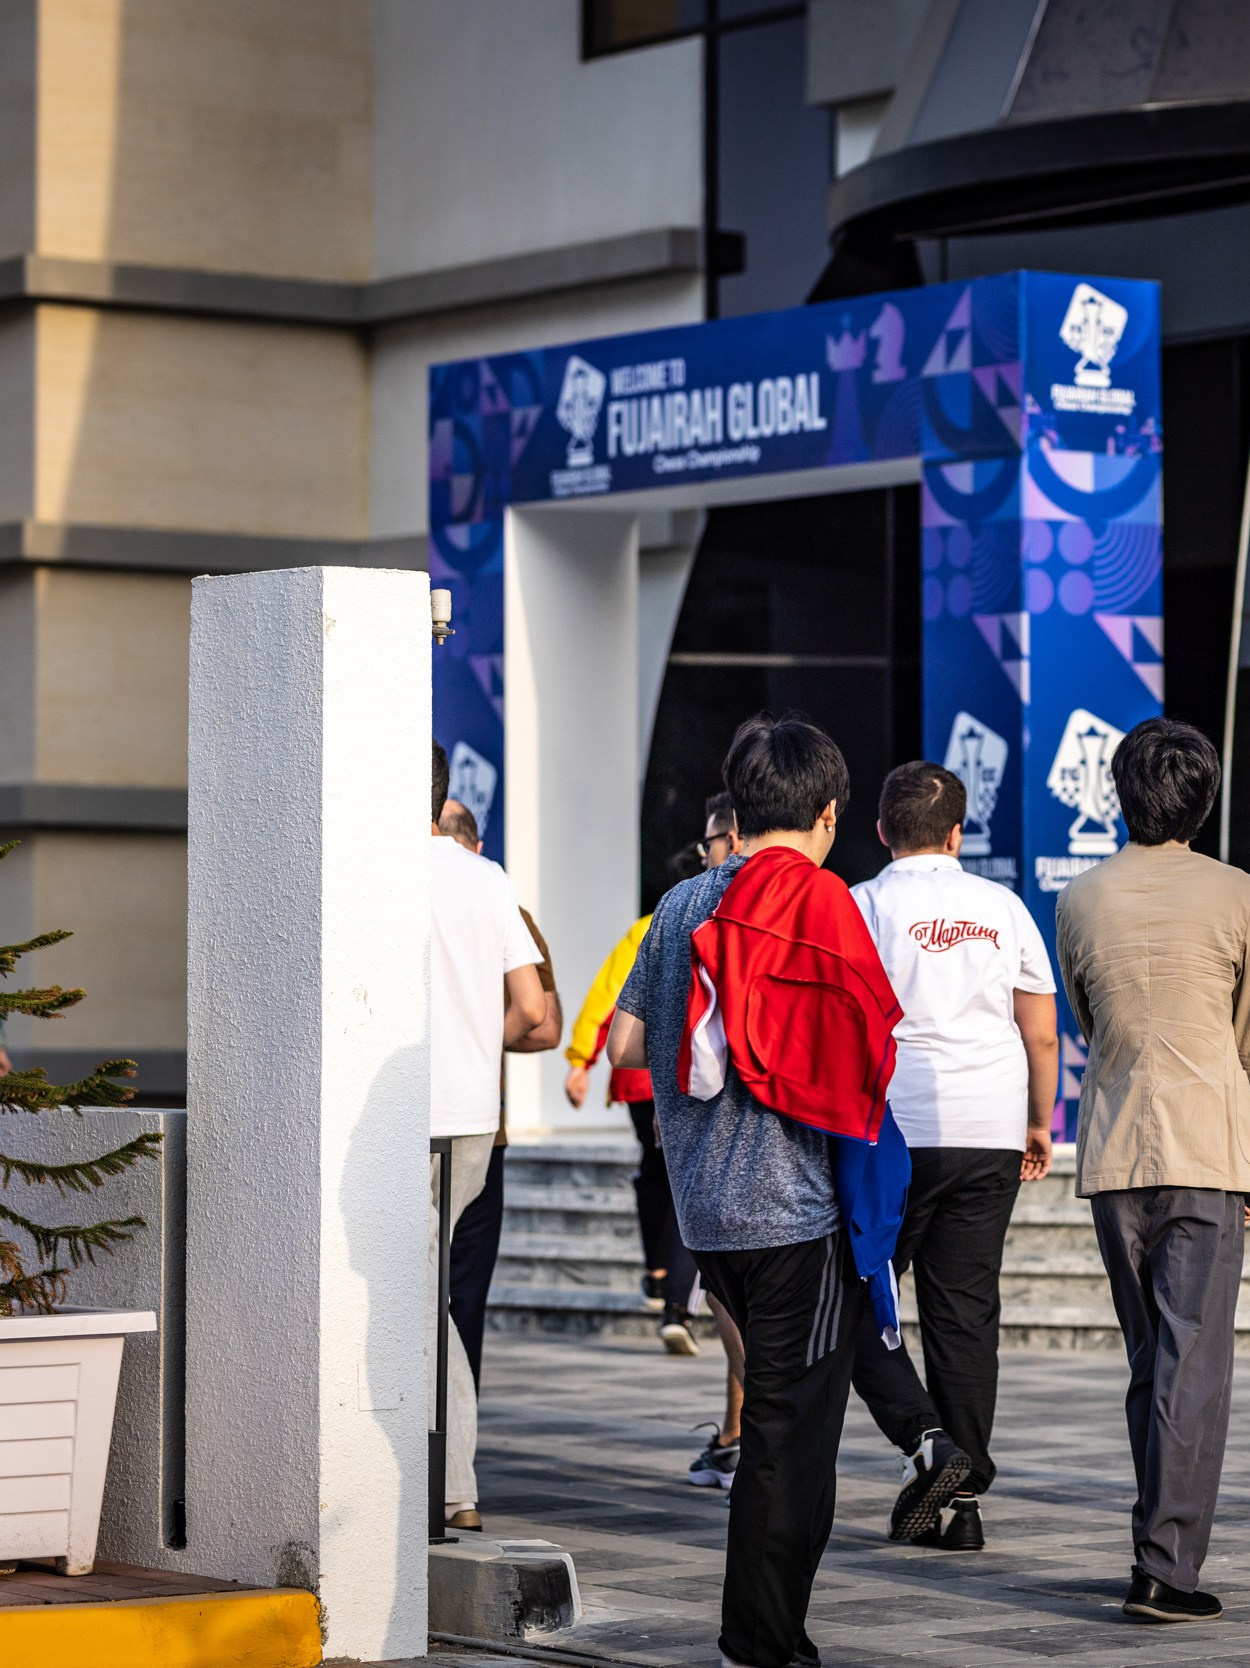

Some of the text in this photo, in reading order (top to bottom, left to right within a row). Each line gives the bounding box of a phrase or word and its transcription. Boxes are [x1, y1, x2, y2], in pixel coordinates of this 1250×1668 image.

[610, 357, 687, 395] WELCOME TO
[607, 372, 828, 459] FUJAIRAH GLOBAL
[925, 918, 1001, 950] Мартина
